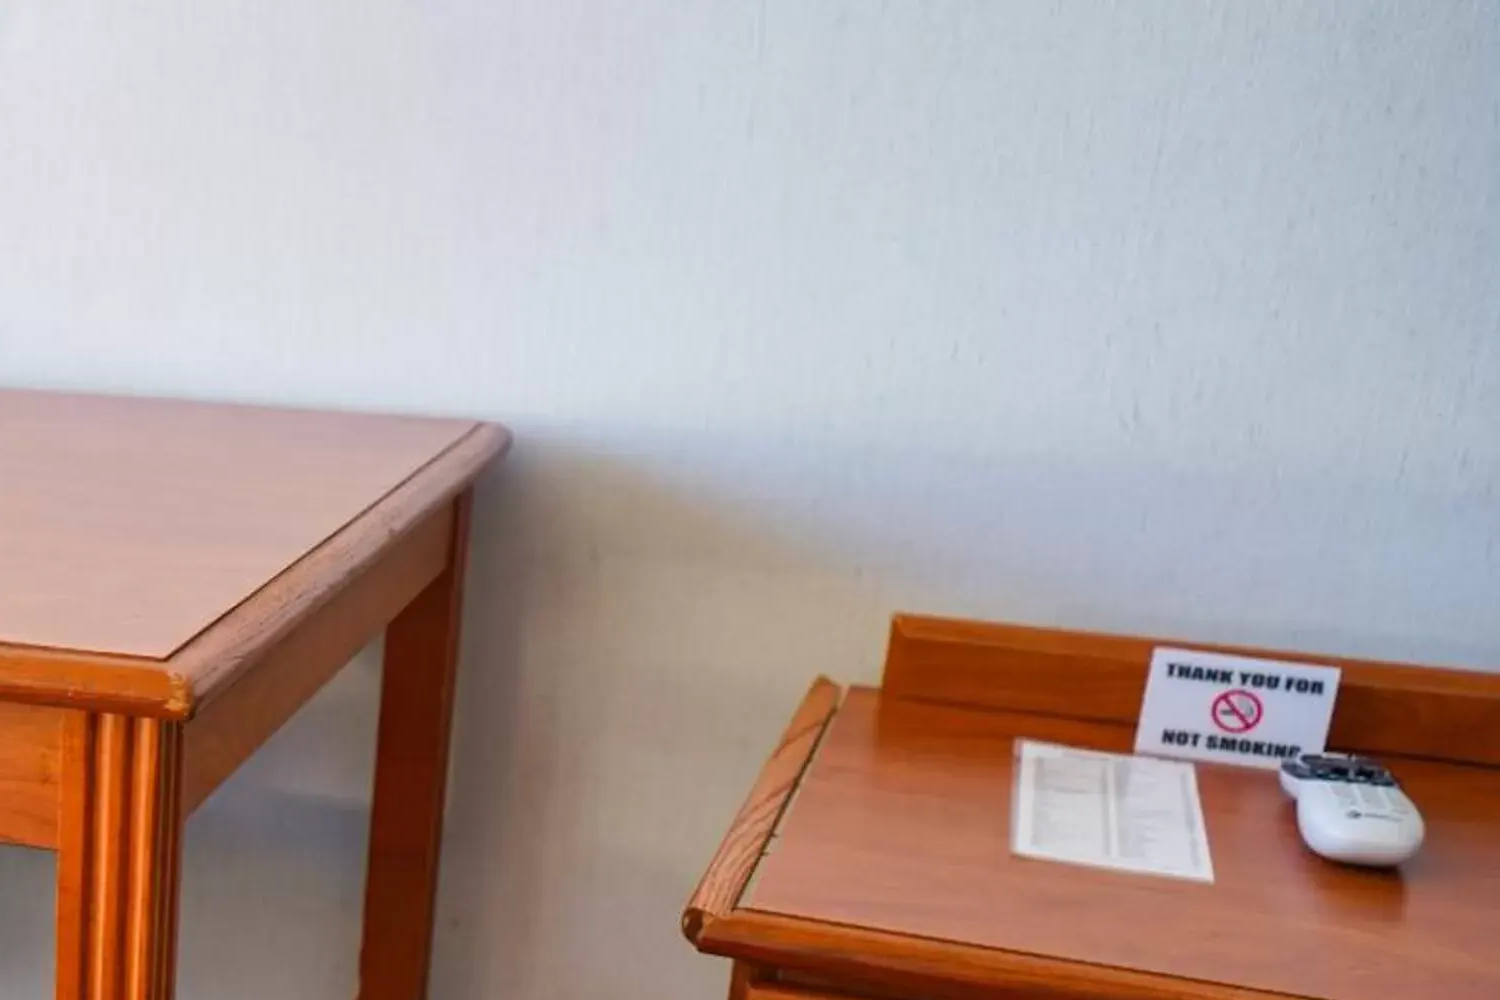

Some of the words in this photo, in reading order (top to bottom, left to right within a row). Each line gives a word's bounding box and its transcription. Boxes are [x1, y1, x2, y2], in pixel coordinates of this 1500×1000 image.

[1166, 663, 1234, 685] THANK
[1239, 672, 1280, 689] YOU
[1284, 677, 1324, 695] FOR
[1161, 729, 1201, 747] NOT
